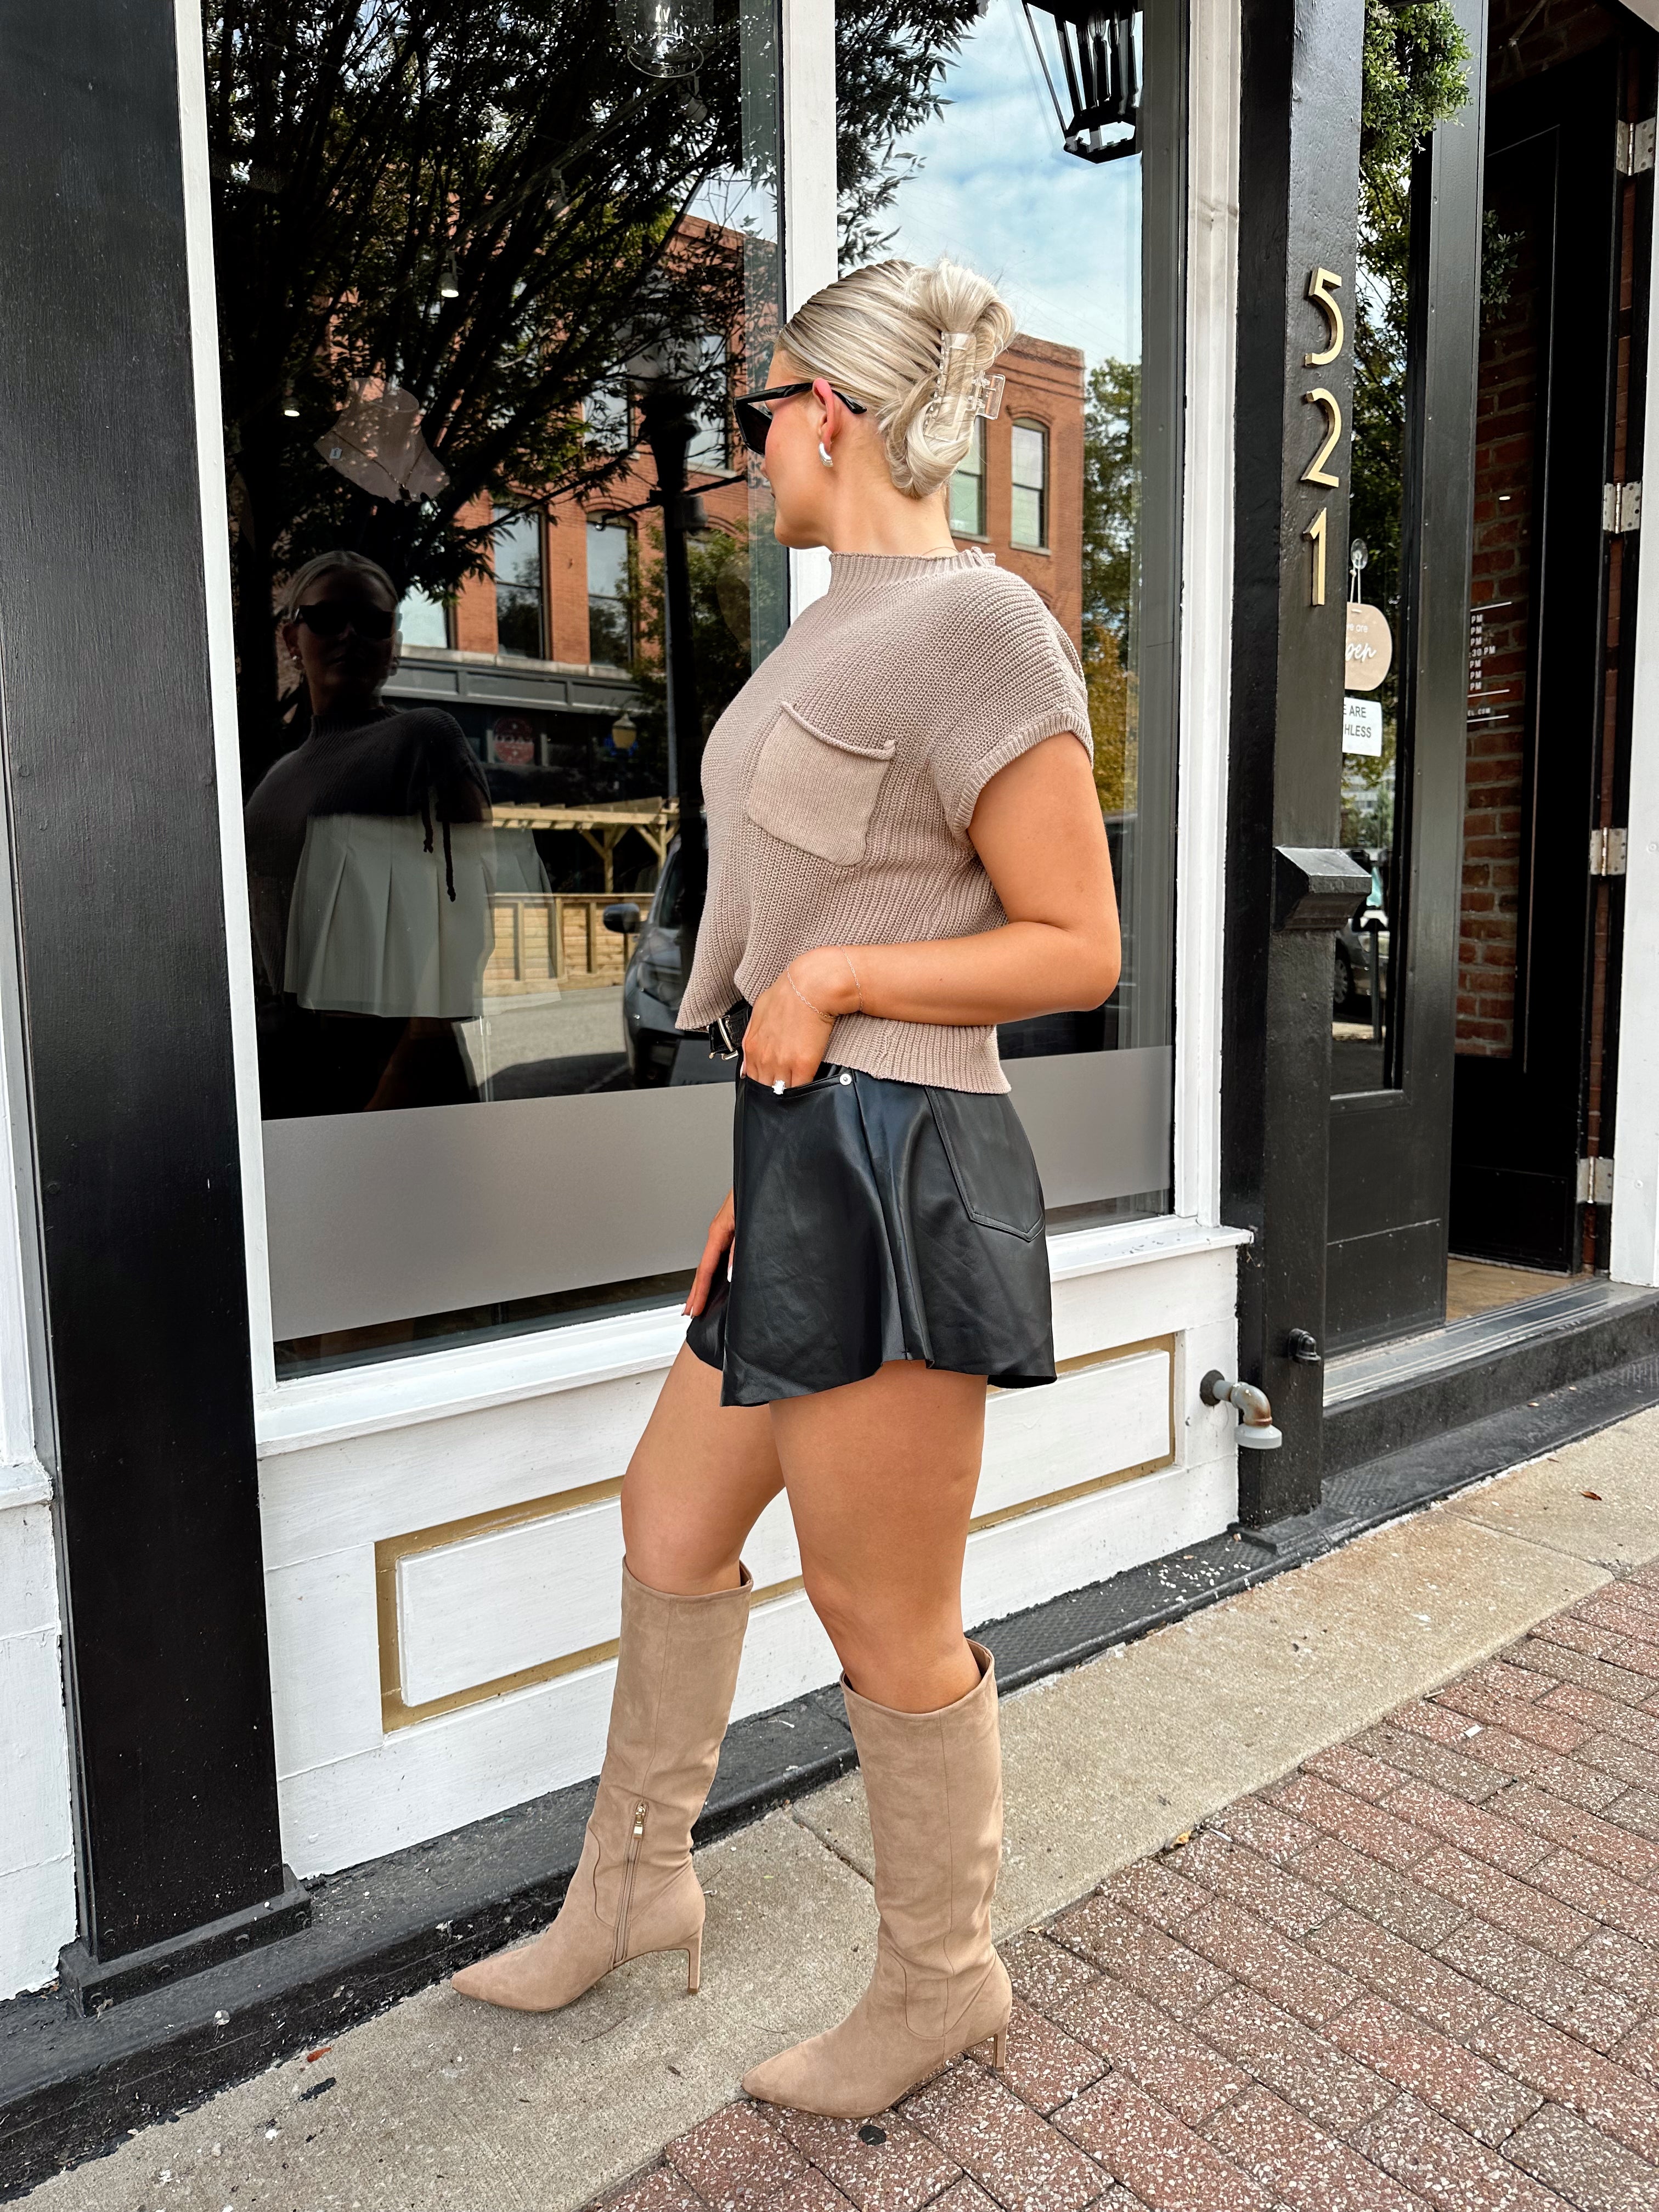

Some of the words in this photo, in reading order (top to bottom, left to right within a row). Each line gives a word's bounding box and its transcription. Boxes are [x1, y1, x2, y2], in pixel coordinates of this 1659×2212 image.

[1300, 267, 1344, 606] 521
[1471, 614, 1483, 624] PM
[1356, 624, 1368, 633] are
[1470, 626, 1482, 635] PM
[1470, 637, 1482, 646] PM
[1483, 645, 1496, 656] PM
[1469, 659, 1481, 669] PM
[1470, 670, 1482, 680] PM
[1470, 681, 1482, 691] PM
[1349, 705, 1367, 718] ARE
